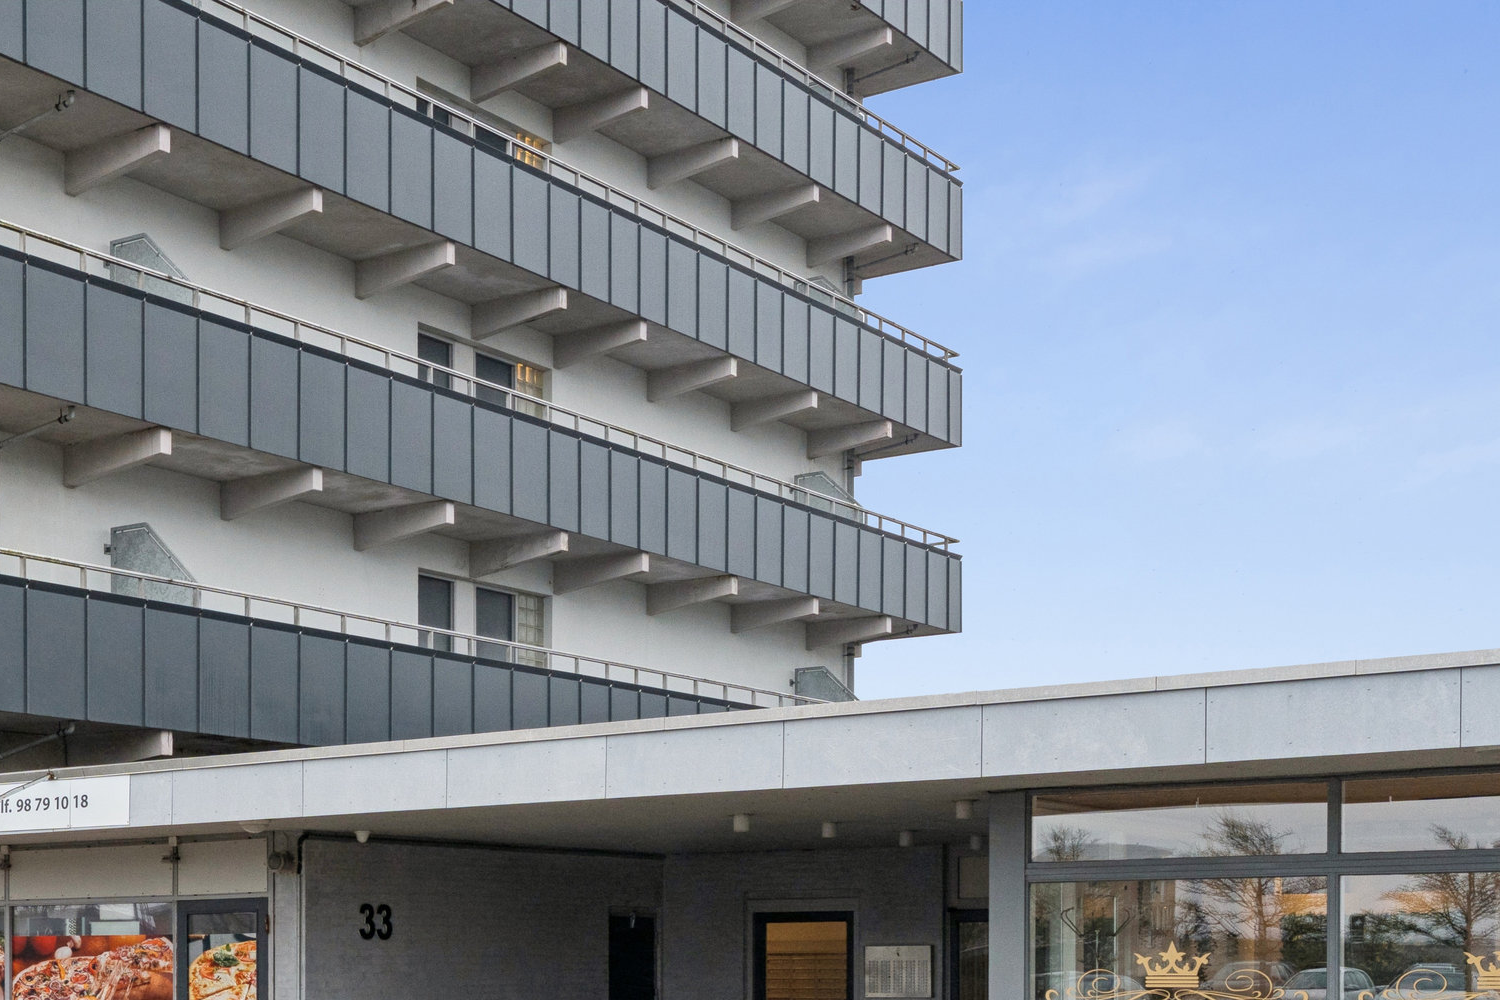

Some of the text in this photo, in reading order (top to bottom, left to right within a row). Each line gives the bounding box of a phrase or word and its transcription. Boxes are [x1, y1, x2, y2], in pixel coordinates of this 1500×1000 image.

[16, 798, 31, 812] 98
[35, 797, 50, 811] 79
[55, 796, 69, 810] 10
[73, 794, 89, 809] 18
[359, 903, 392, 940] 33
